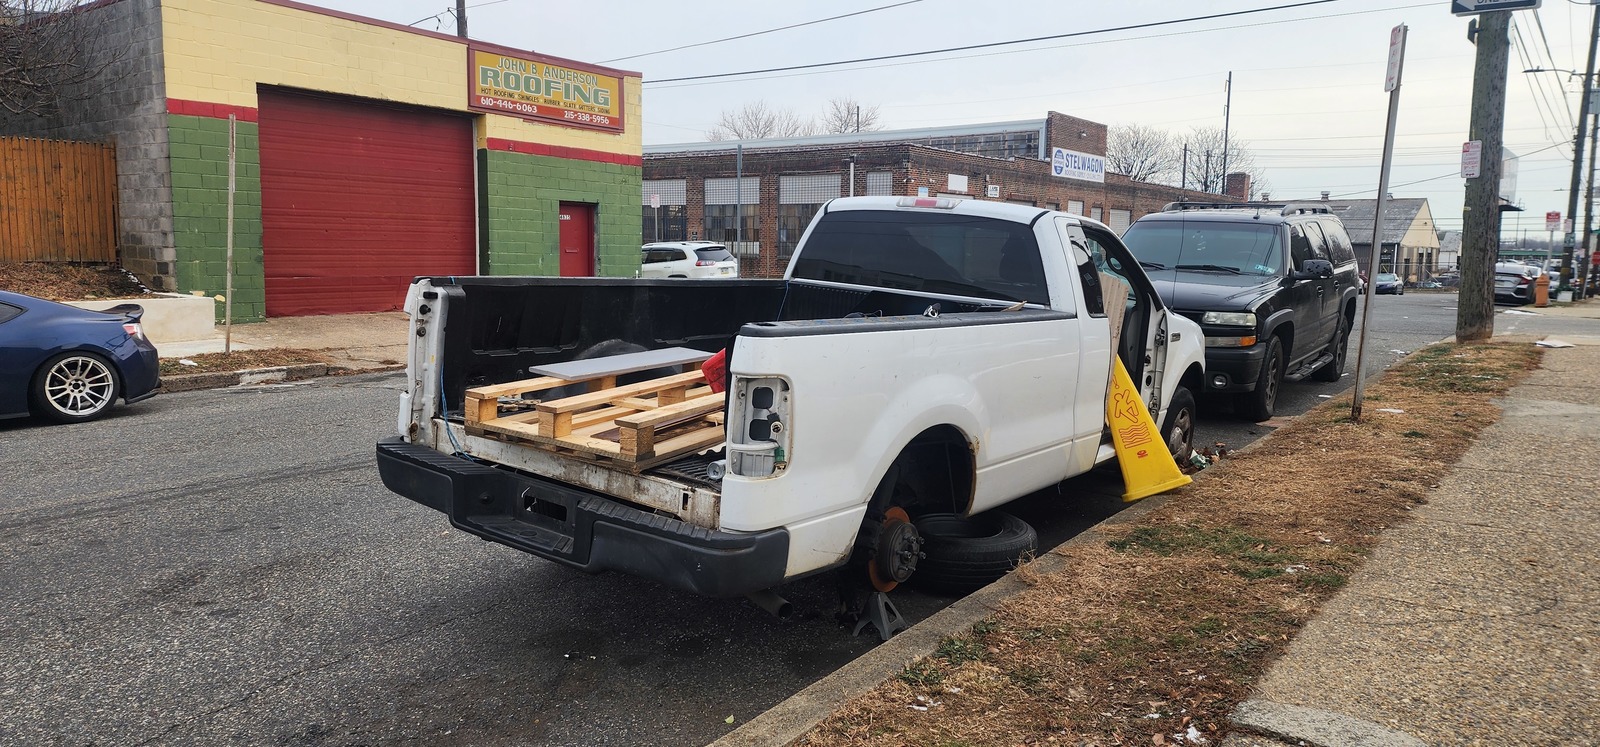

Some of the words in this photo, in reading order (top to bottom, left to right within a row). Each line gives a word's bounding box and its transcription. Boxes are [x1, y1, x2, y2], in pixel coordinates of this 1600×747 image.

[497, 57, 527, 73] JOHN
[543, 66, 598, 86] ANDERSON
[480, 66, 610, 107] ROOFING
[481, 97, 537, 112] 610-446-6063
[494, 90, 516, 99] ROOFING
[517, 94, 539, 103] SHINGLES
[544, 98, 560, 106] RUBBER
[578, 104, 596, 112] GUTTERS
[564, 110, 610, 124] 215-338-5956
[1066, 153, 1103, 173] STELWAGON
